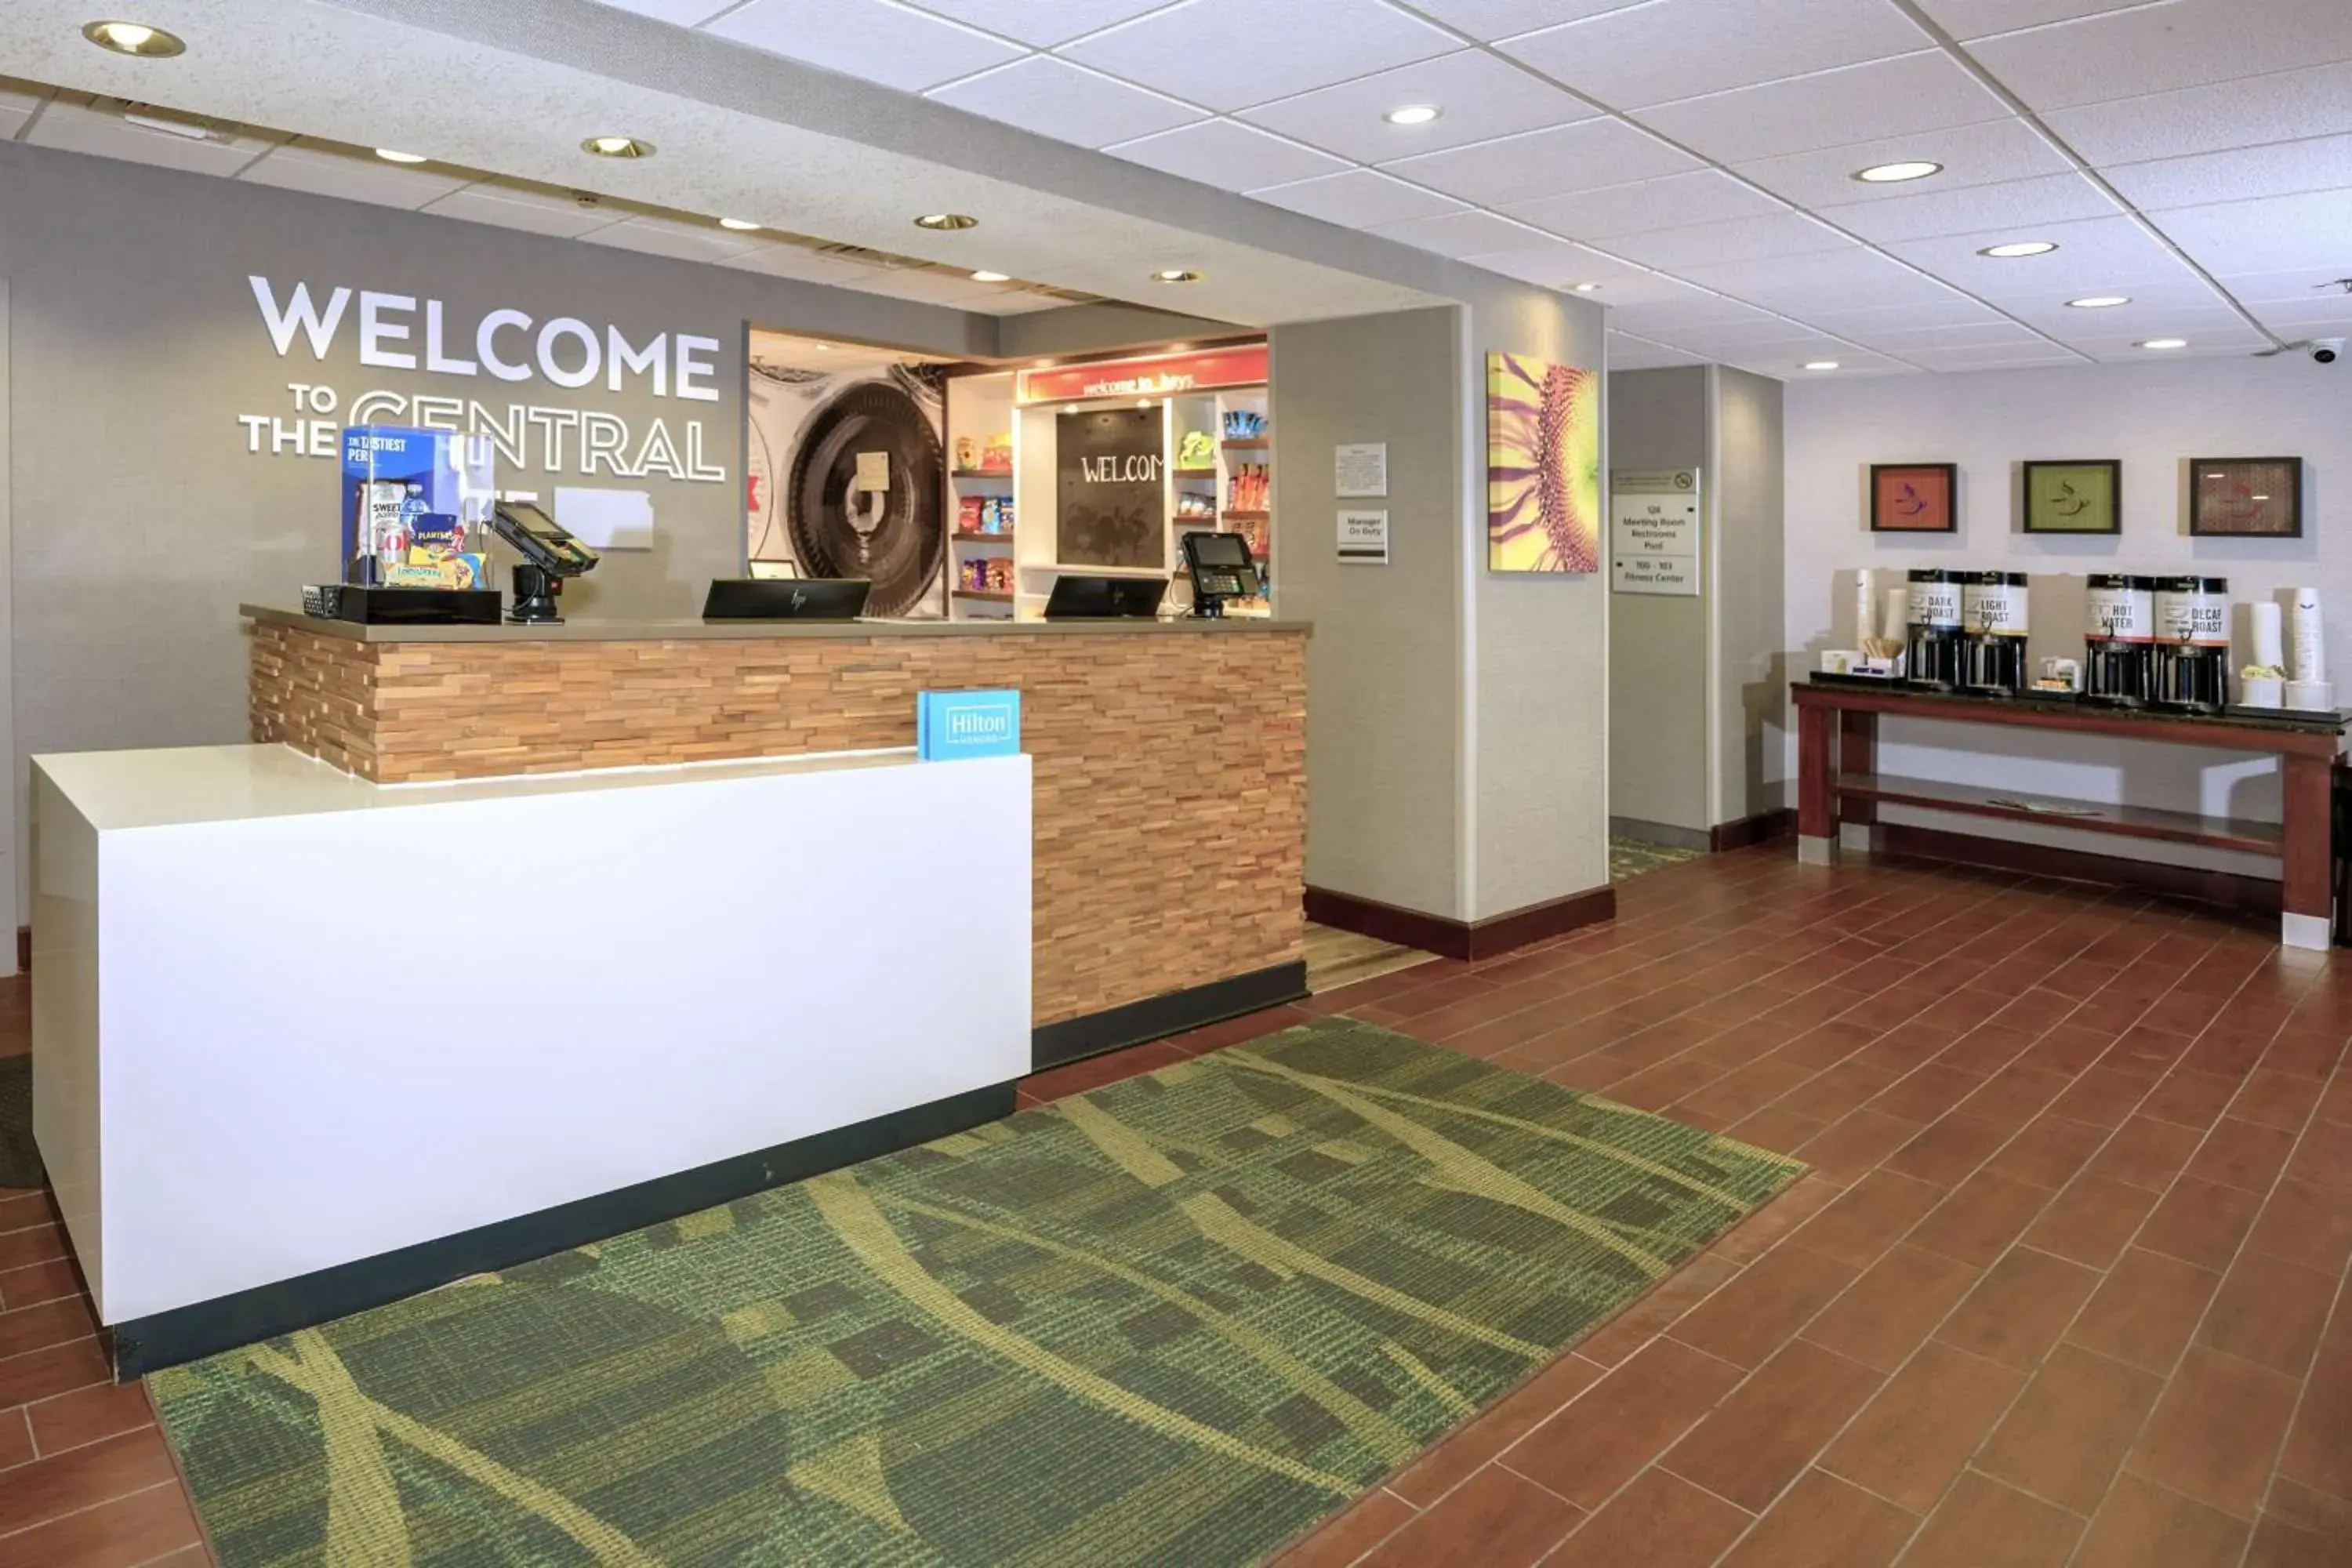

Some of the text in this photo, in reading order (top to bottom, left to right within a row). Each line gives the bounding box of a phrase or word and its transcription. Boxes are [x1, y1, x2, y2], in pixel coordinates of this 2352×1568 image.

[248, 275, 720, 401] WELCOME
[287, 382, 337, 414] TO
[238, 413, 337, 456] THE
[1348, 517, 1381, 527] Manager
[1623, 517, 1658, 528] Meeting
[1363, 527, 1381, 536] Duty
[1632, 529, 1677, 539] Restrooms
[1624, 572, 1684, 583] Fitness Center
[1928, 596, 1953, 606] DARK
[1981, 600, 2008, 610] LIGHT
[2113, 604, 2132, 616] HOT
[2191, 608, 2222, 620] DECAF
[2102, 616, 2133, 629] WATER
[2191, 621, 2223, 633] ROAST
[952, 713, 1006, 734] Hilton
